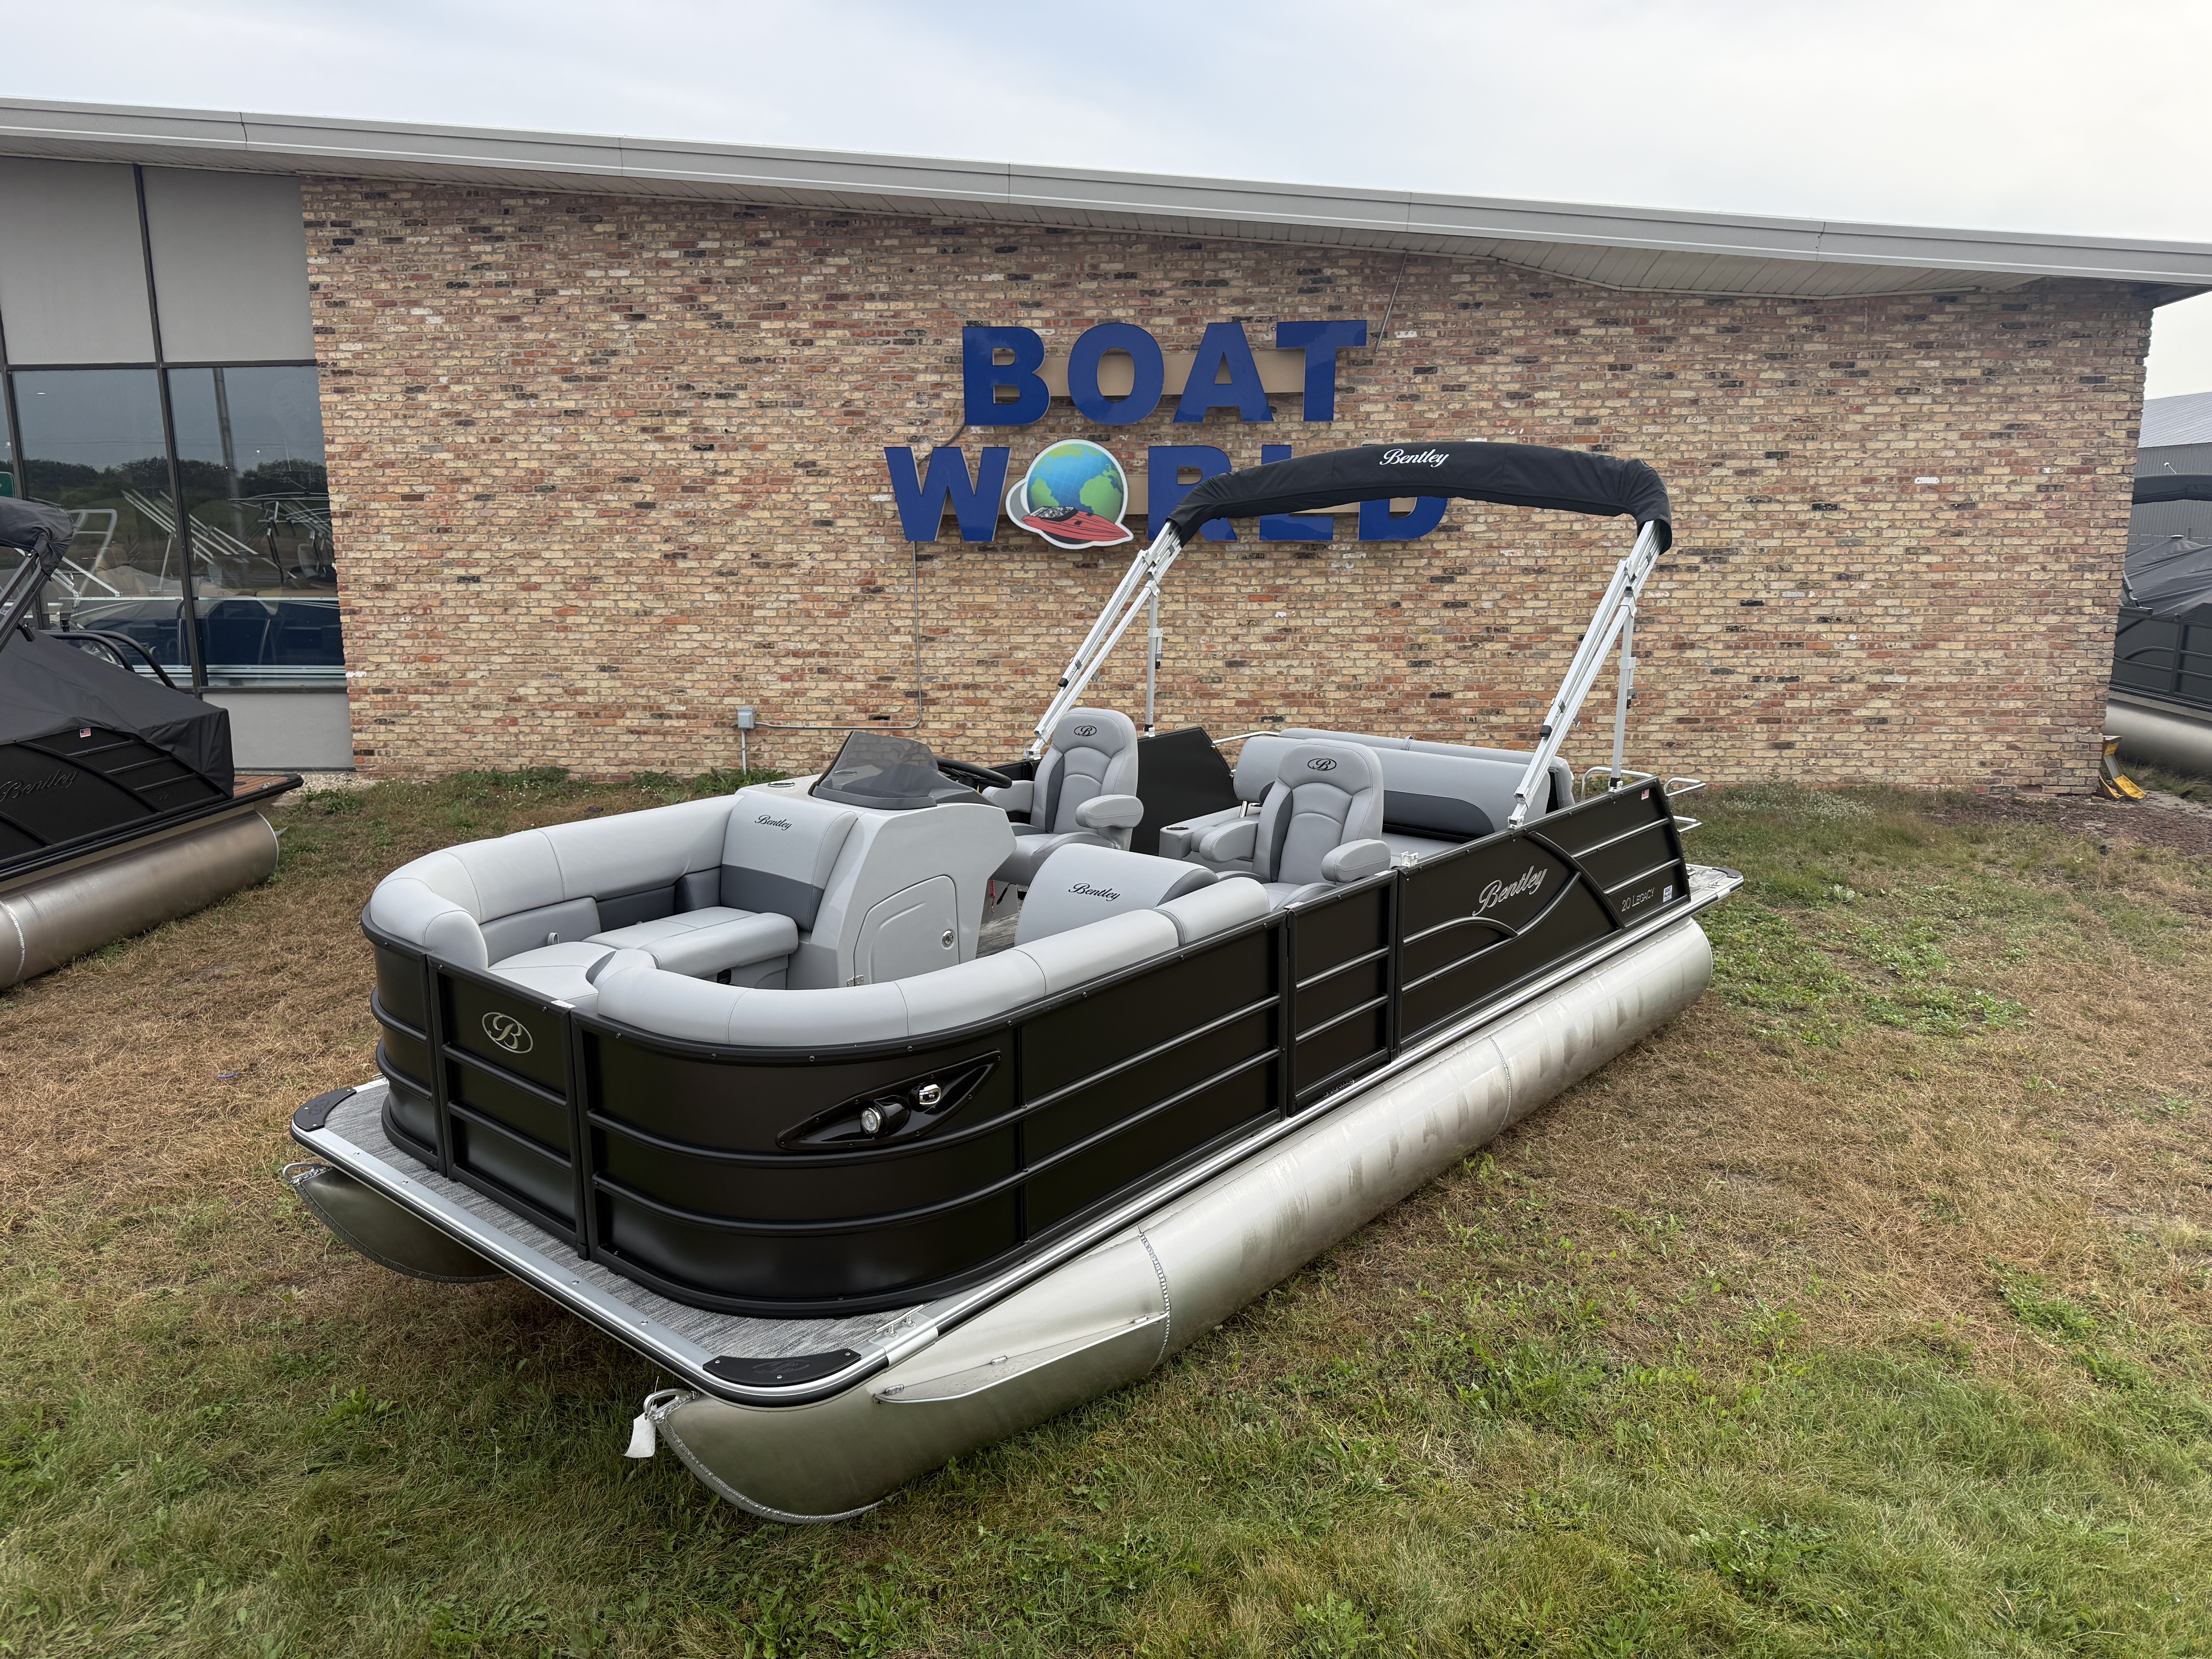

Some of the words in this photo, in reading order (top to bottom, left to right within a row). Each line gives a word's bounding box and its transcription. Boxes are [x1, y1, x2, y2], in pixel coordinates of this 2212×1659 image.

[962, 320, 1367, 425] BOAT
[1379, 448, 1449, 467] Bentley
[0, 769, 77, 802] Bentley
[755, 814, 792, 831] Bentley
[1068, 883, 1121, 902] Bentley
[1472, 865, 1547, 916] Bentley
[1621, 897, 1631, 912] 20
[1632, 887, 1655, 907] LEGACY
